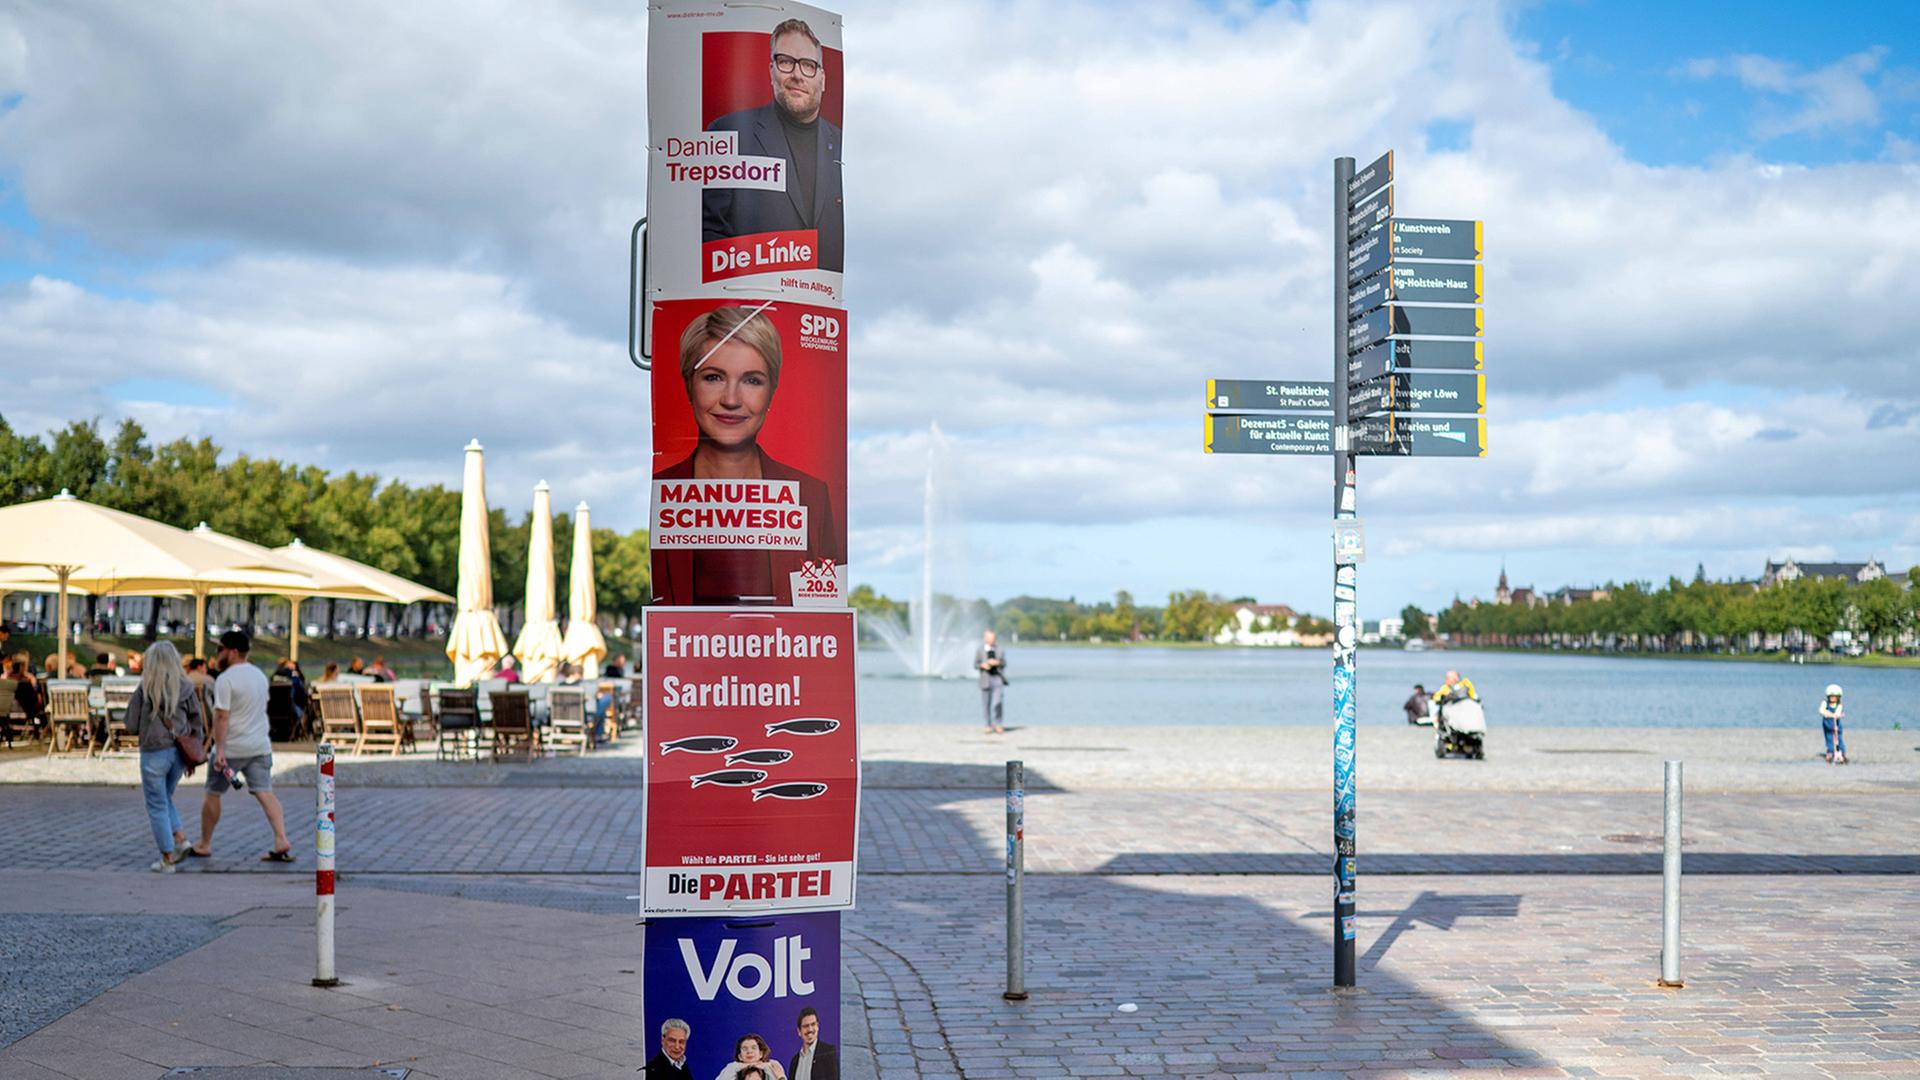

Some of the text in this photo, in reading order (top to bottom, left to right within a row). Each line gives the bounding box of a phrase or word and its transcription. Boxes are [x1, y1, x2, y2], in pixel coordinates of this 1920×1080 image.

[667, 135, 734, 157] Daniel
[666, 162, 781, 185] Trepsdorf
[1399, 223, 1451, 234] Kunstverein
[712, 237, 812, 273] Die Linke
[1401, 247, 1423, 256] Society
[781, 277, 834, 295] hilft im Alltag.
[800, 313, 840, 338] SPD
[1266, 386, 1329, 396] St. Paulskirche
[1434, 389, 1458, 399] Löwe
[1308, 399, 1329, 407] Church
[1241, 419, 1287, 429] Dezernat5
[1297, 420, 1329, 429] Galerie
[1399, 422, 1450, 431] Marien und
[1249, 430, 1329, 441] für aktuelle Kunst
[1270, 443, 1329, 453] Contemporary Arts
[660, 484, 795, 504] MANUELA
[659, 508, 802, 529] SCHWESIG
[659, 533, 802, 546] ENTSCHEIDUNG FÜR MV.
[806, 580, 838, 593] 20.9.
[663, 627, 838, 658] Erneuerbare
[663, 675, 800, 707] Sardinen!
[681, 855, 703, 864] Wählt
[705, 855, 717, 864] Die
[719, 855, 757, 864] PARTEI
[765, 854, 776, 863] Sie
[778, 854, 787, 862] ist
[789, 853, 804, 862] sehr
[806, 853, 821, 863] gut!
[677, 935, 815, 1001] Volt
